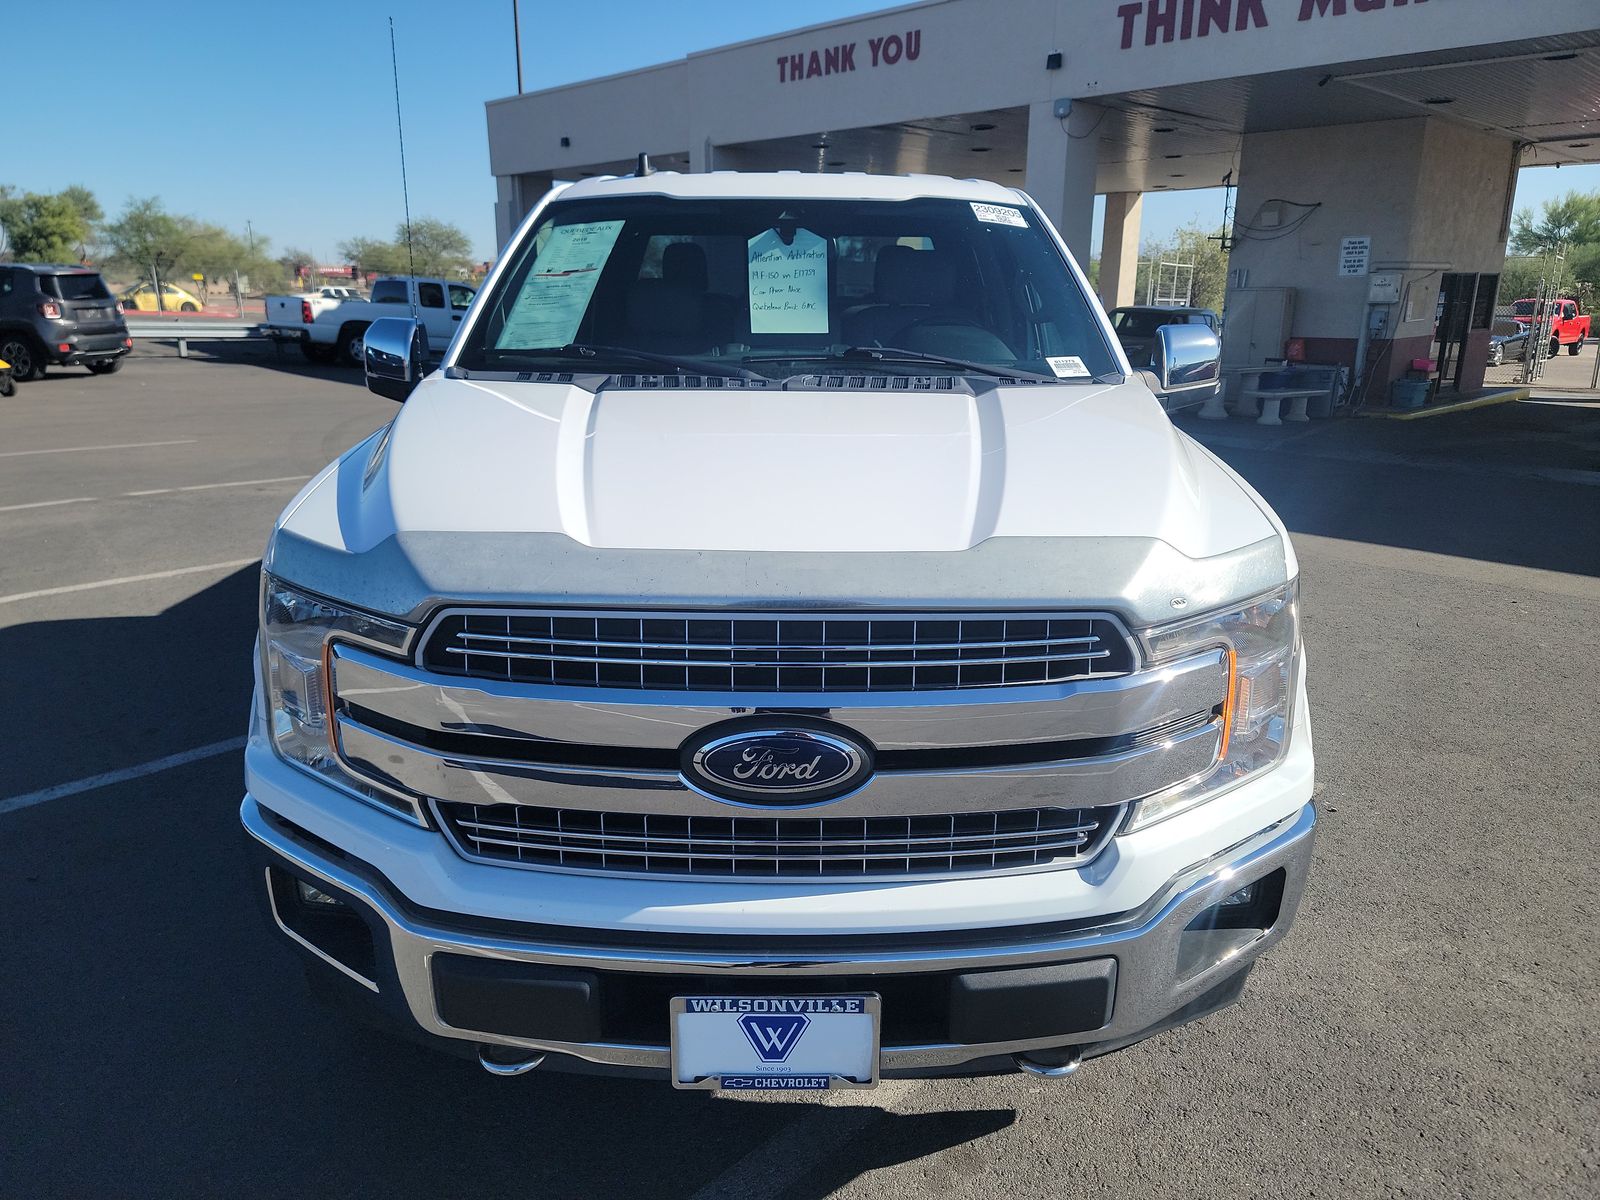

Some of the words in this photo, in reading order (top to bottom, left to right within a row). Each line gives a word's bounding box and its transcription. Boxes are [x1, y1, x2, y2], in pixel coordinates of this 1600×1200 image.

[1117, 0, 1268, 49] THINK
[777, 43, 856, 83] THANK
[868, 29, 921, 67] YOU
[750, 250, 782, 263] Attention
[787, 250, 825, 260] Arbitration
[733, 747, 821, 779] Ford
[691, 1000, 860, 1013] WILSONVILLE
[755, 1078, 827, 1087] CHEVROLET
